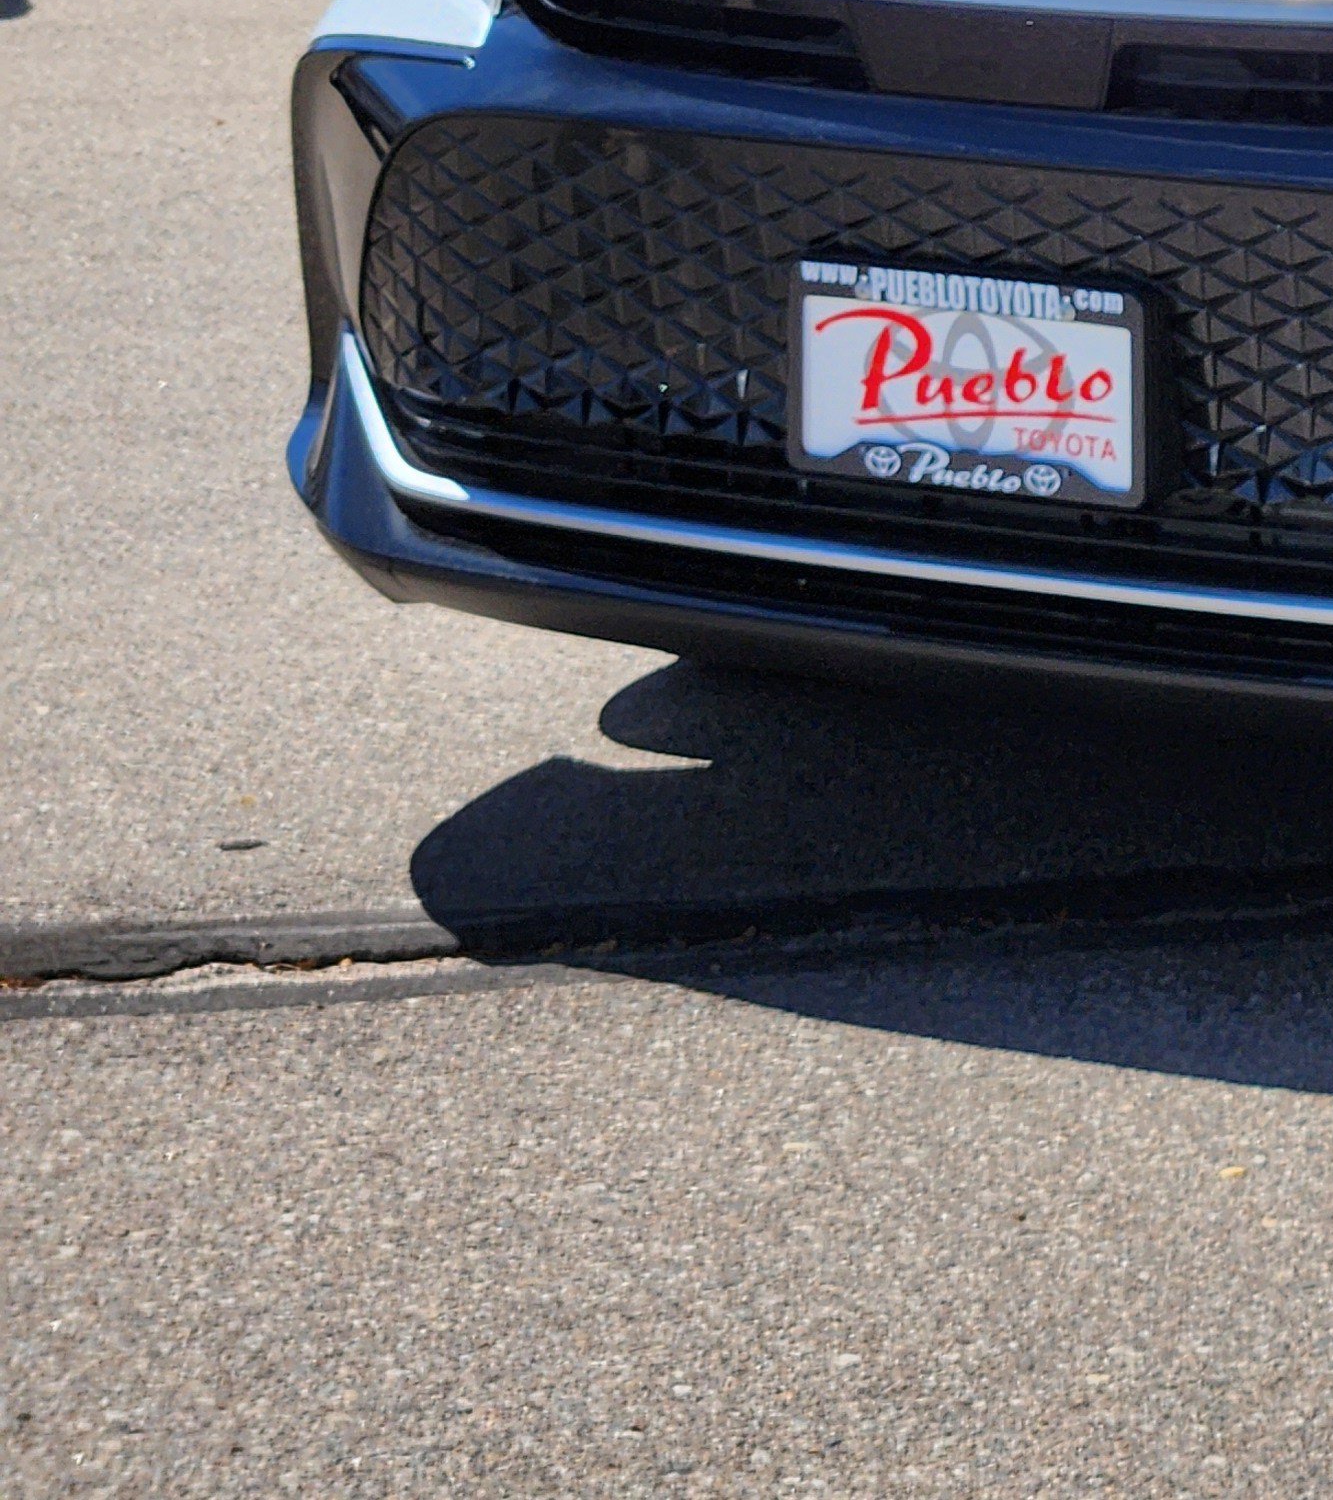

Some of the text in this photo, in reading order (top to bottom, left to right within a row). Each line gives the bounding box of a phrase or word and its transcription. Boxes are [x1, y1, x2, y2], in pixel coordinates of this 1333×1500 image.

[815, 308, 1113, 411] Pueblo
[898, 442, 1022, 494] Pueblo
[1013, 426, 1117, 462] TOYOTA
